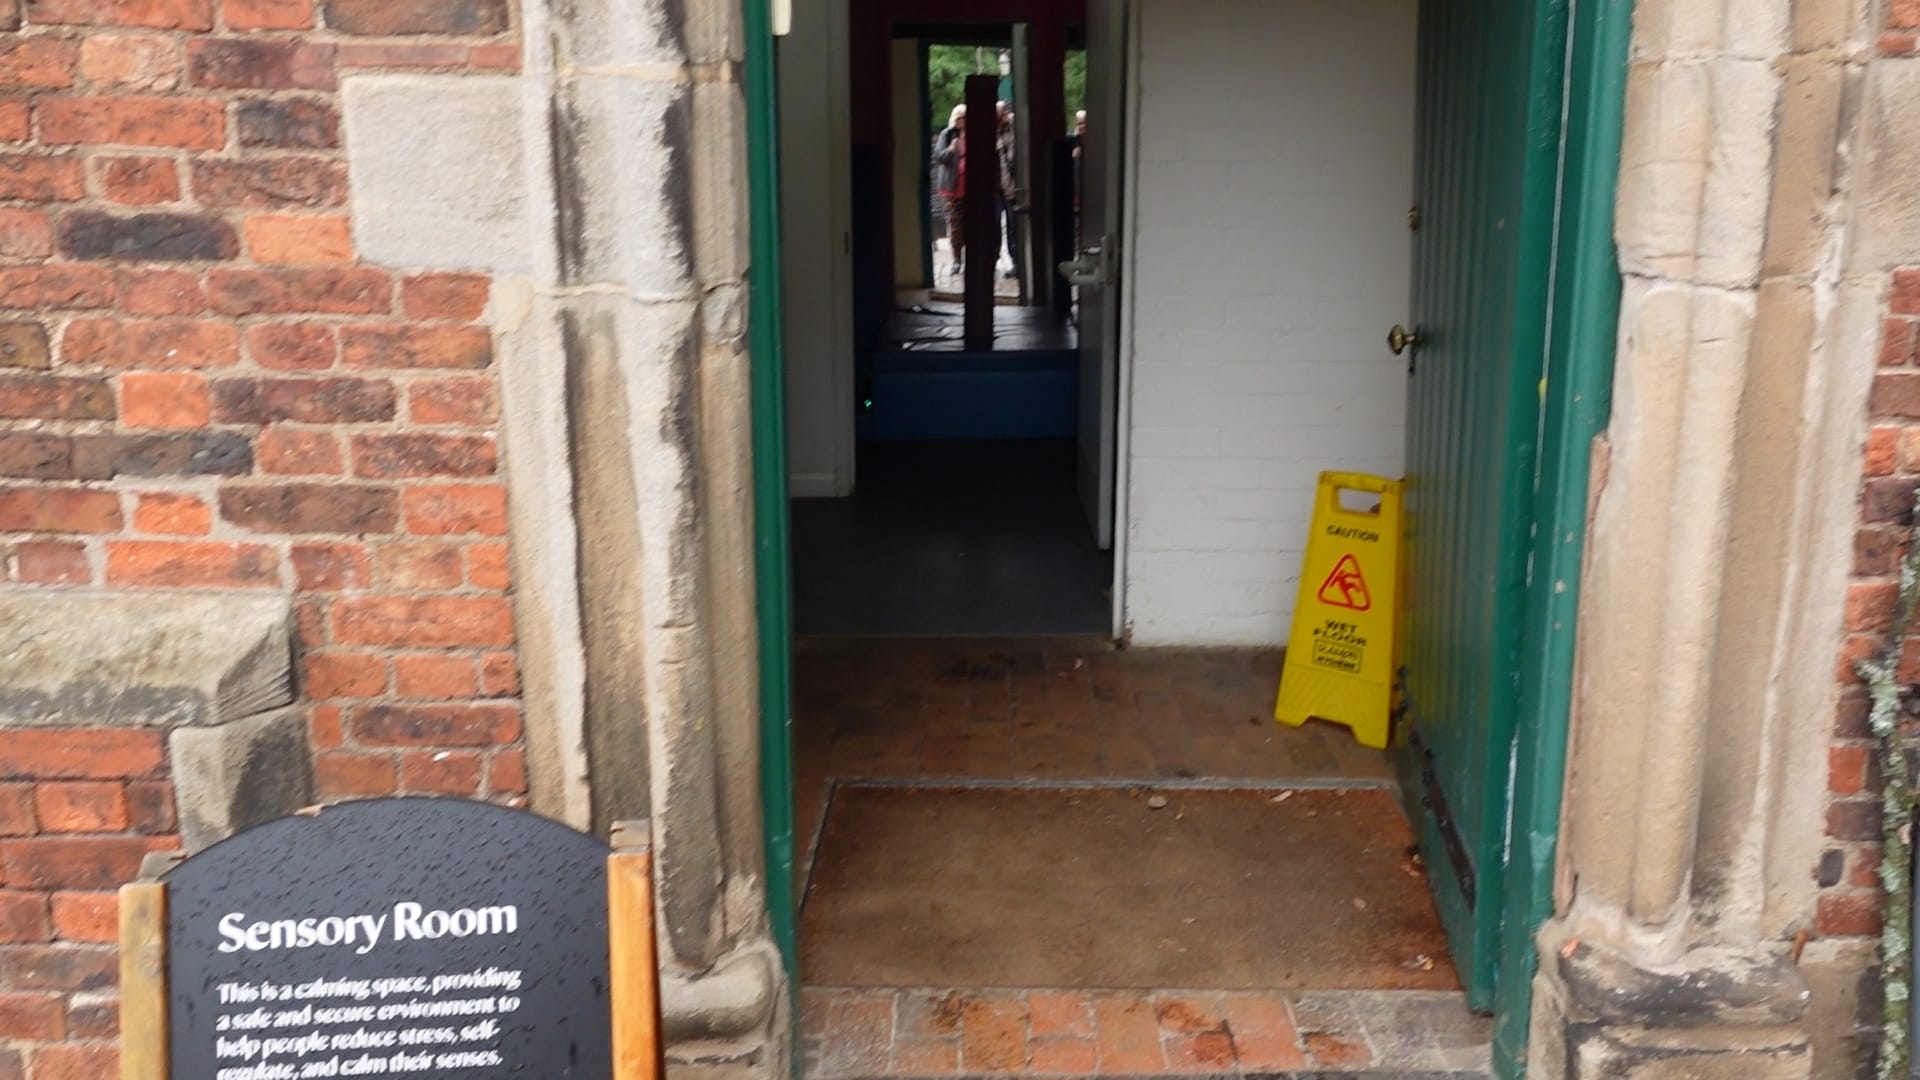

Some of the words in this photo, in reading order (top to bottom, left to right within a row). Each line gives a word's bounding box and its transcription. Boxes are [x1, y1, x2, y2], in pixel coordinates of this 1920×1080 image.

[1326, 524, 1380, 543] CAUTION
[1313, 628, 1368, 647] FLOOR
[1325, 619, 1359, 634] WET
[217, 912, 387, 954] Sensory
[394, 902, 517, 940] Room
[216, 981, 260, 1004] This
[261, 980, 279, 1001] is
[279, 984, 293, 1001] a
[294, 976, 371, 1000] calming
[371, 976, 432, 999] space,
[432, 966, 522, 996] providing
[216, 1014, 231, 1031] a
[231, 1006, 273, 1030] safe
[273, 1003, 312, 1028] and
[313, 1005, 377, 1025] secure
[377, 998, 497, 1021] environment
[498, 995, 521, 1013] to
[216, 1034, 261, 1061] help
[262, 1030, 330, 1060] people
[331, 1027, 397, 1050] reduce
[398, 1026, 459, 1046] stress,
[460, 1018, 501, 1042] self-
[300, 1055, 339, 1079] and
[340, 1053, 388, 1075] calm
[389, 1050, 436, 1073] their
